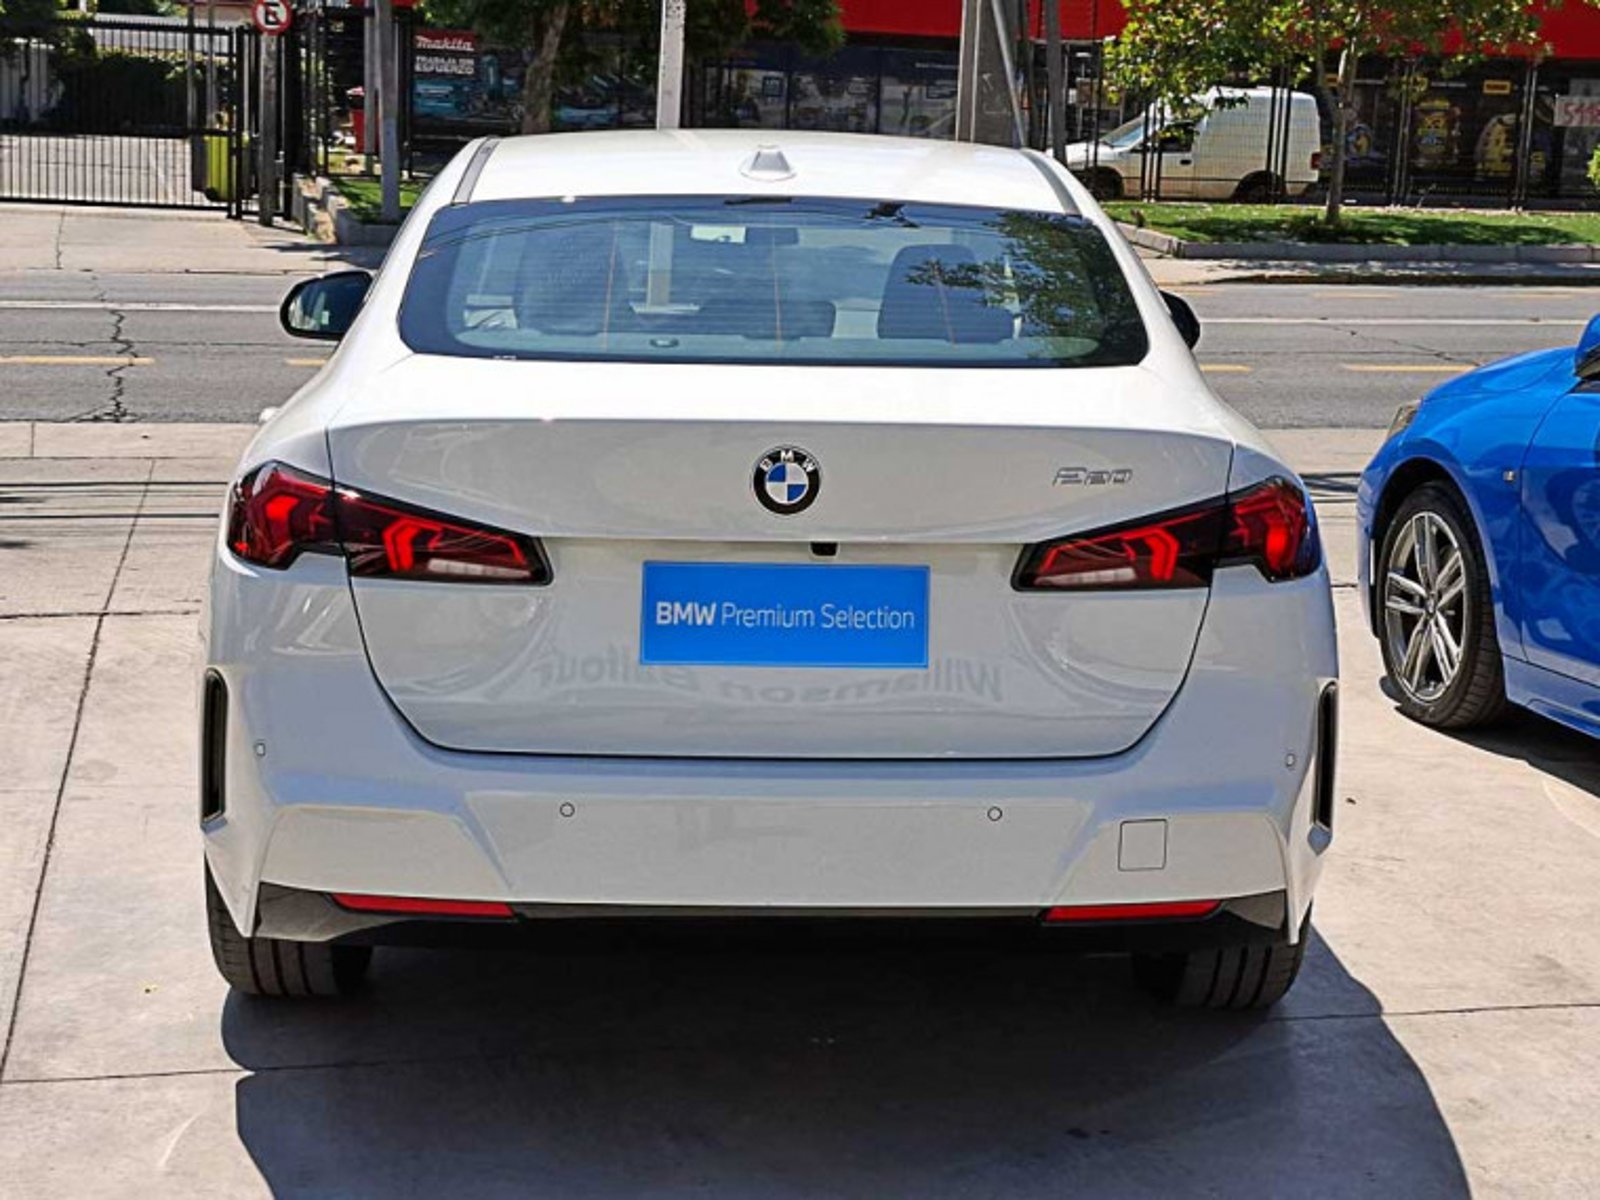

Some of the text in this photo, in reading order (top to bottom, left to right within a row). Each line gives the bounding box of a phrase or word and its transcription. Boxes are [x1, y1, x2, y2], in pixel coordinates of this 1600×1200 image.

[760, 449, 816, 472] BMW
[656, 602, 915, 630] BMW Premium Selection
